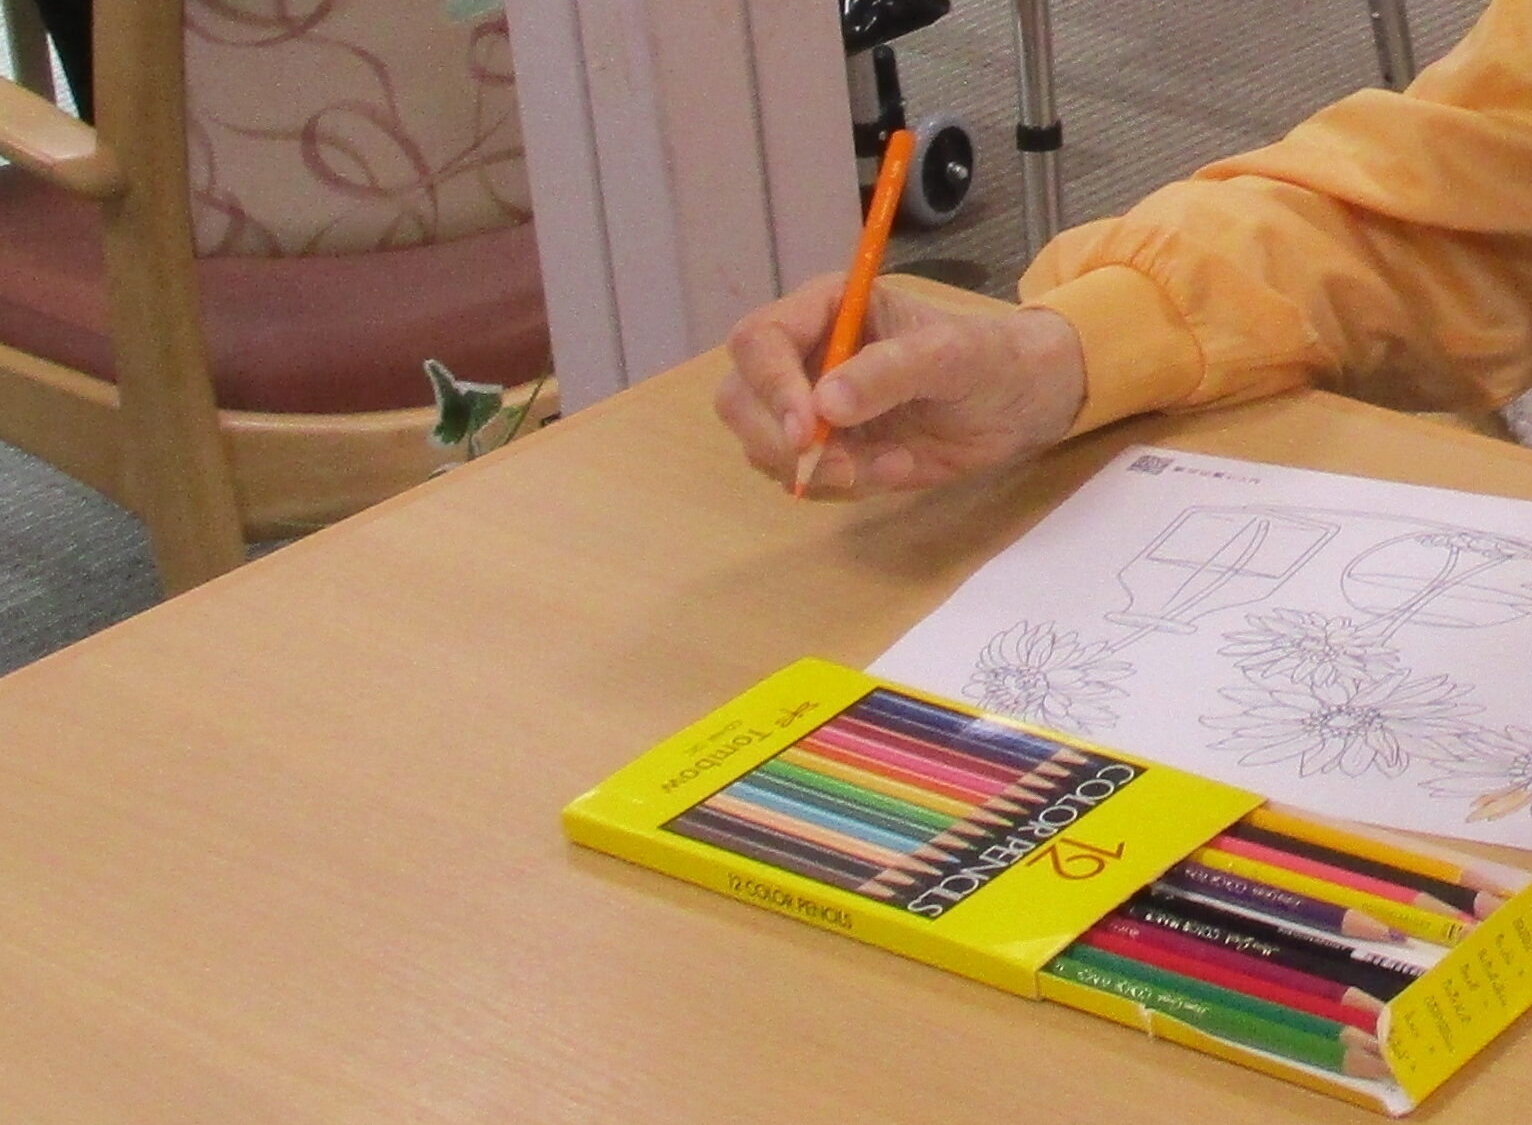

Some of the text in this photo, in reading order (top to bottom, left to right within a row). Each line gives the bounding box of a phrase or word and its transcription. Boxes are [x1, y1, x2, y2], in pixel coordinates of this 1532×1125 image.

[660, 728, 775, 794] Tombow
[907, 763, 1135, 917] COLOR PENCILS
[1025, 837, 1125, 880] 12
